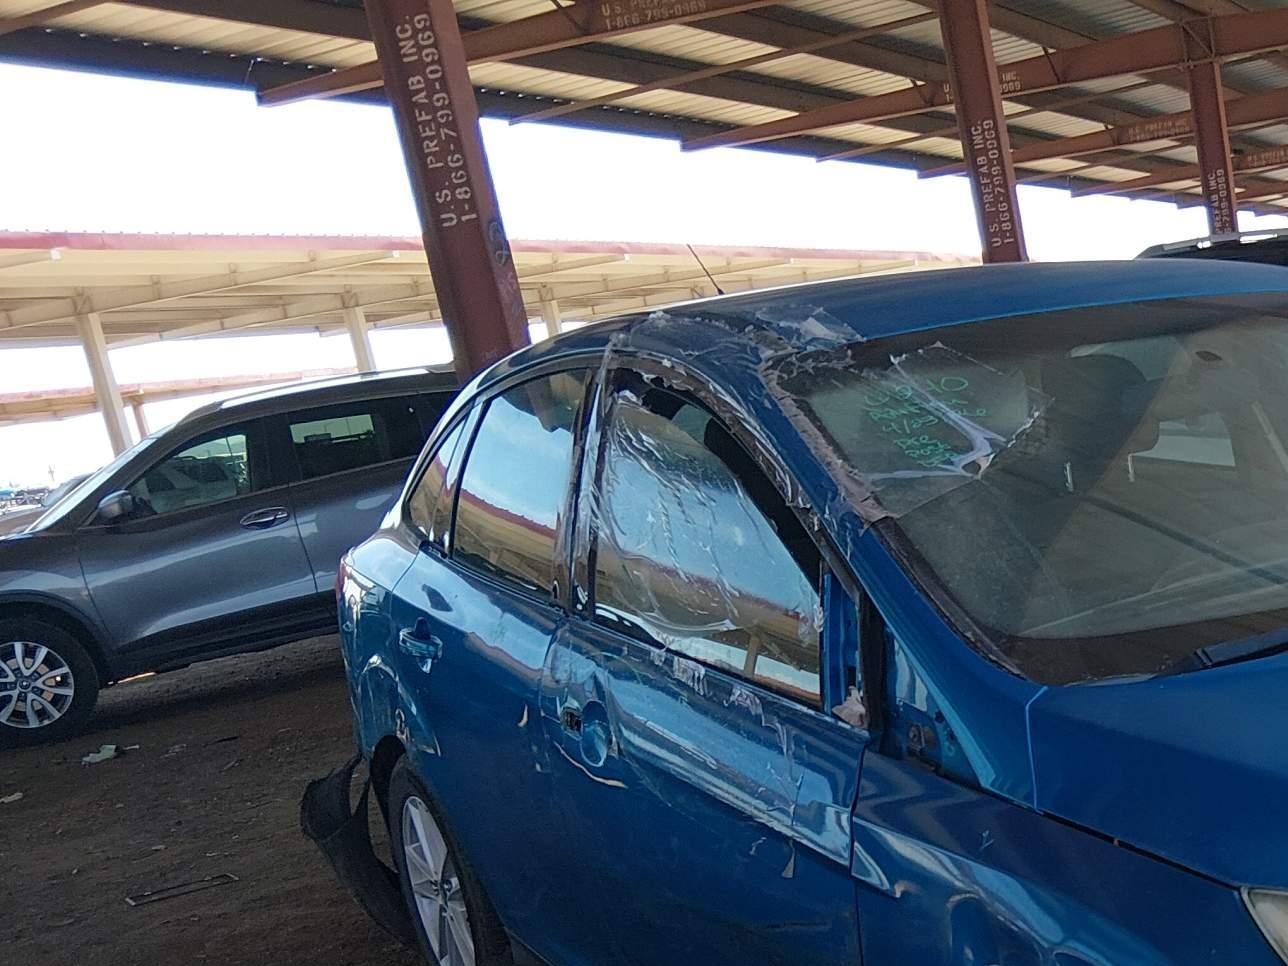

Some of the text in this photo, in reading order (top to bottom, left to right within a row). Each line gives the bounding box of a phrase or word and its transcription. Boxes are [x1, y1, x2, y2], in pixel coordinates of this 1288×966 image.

[395, 15, 458, 227] U.S. PREFAB INC.
[414, 13, 478, 223] 1-866-799-0969
[971, 120, 1002, 247] U.S. PREFAB INC.
[982, 119, 1015, 244] 1-866-799-0969
